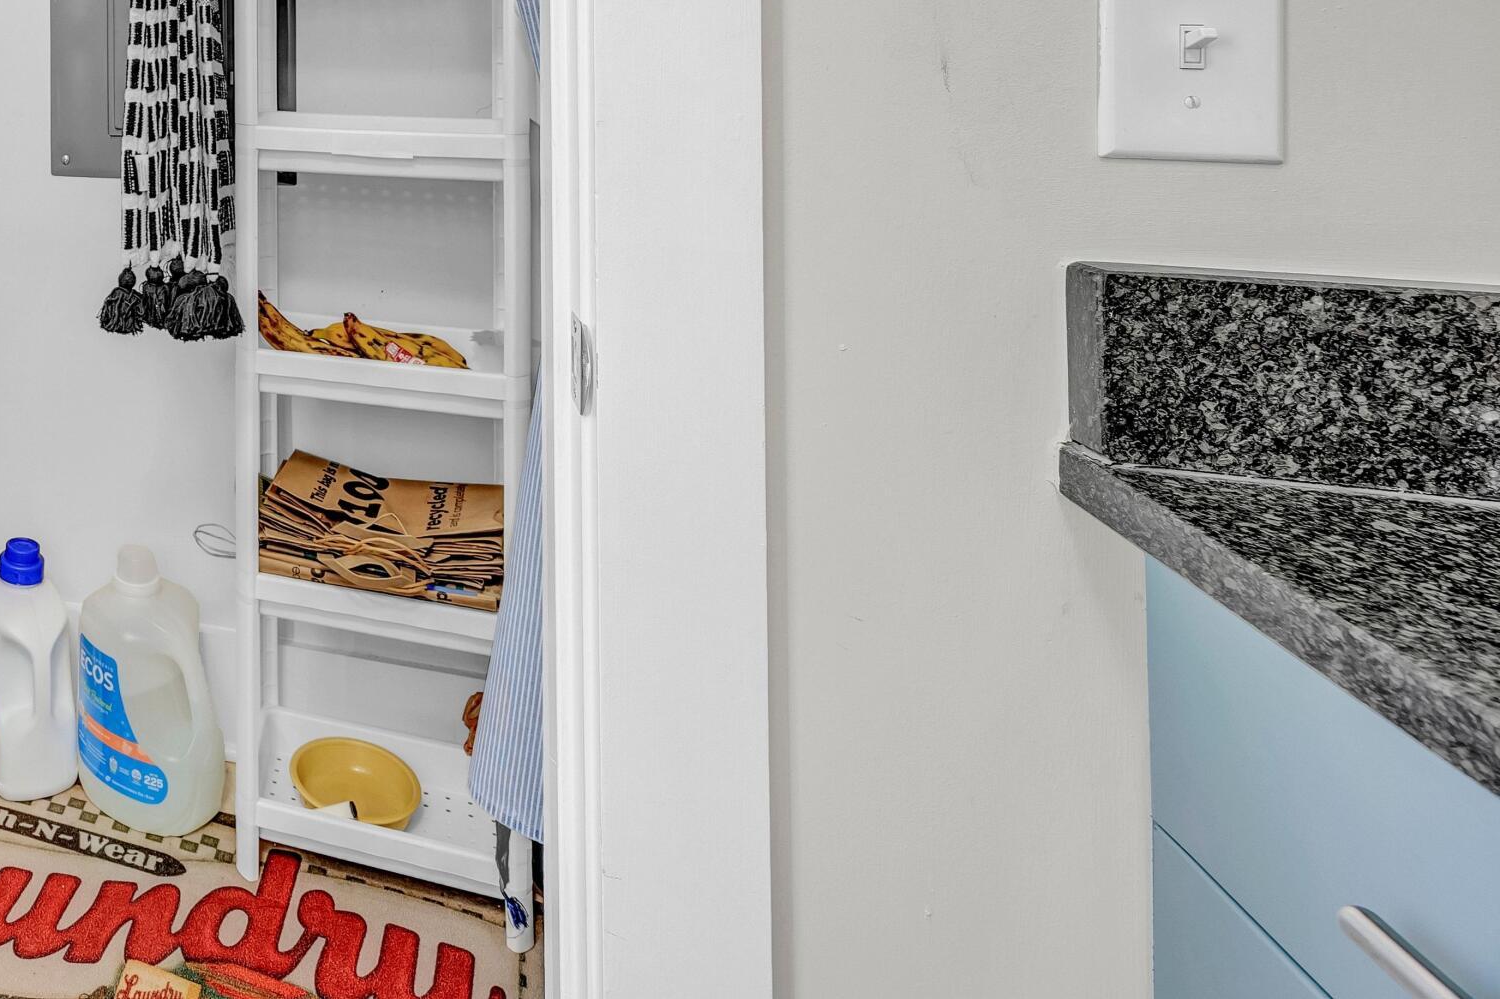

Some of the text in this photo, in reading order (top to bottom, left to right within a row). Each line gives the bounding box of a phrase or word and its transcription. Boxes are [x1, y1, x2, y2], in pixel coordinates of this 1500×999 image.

[310, 486, 328, 503] This
[321, 472, 337, 489] bag
[426, 486, 449, 531] recycled
[81, 648, 114, 692] ECOS
[143, 774, 164, 789] 225
